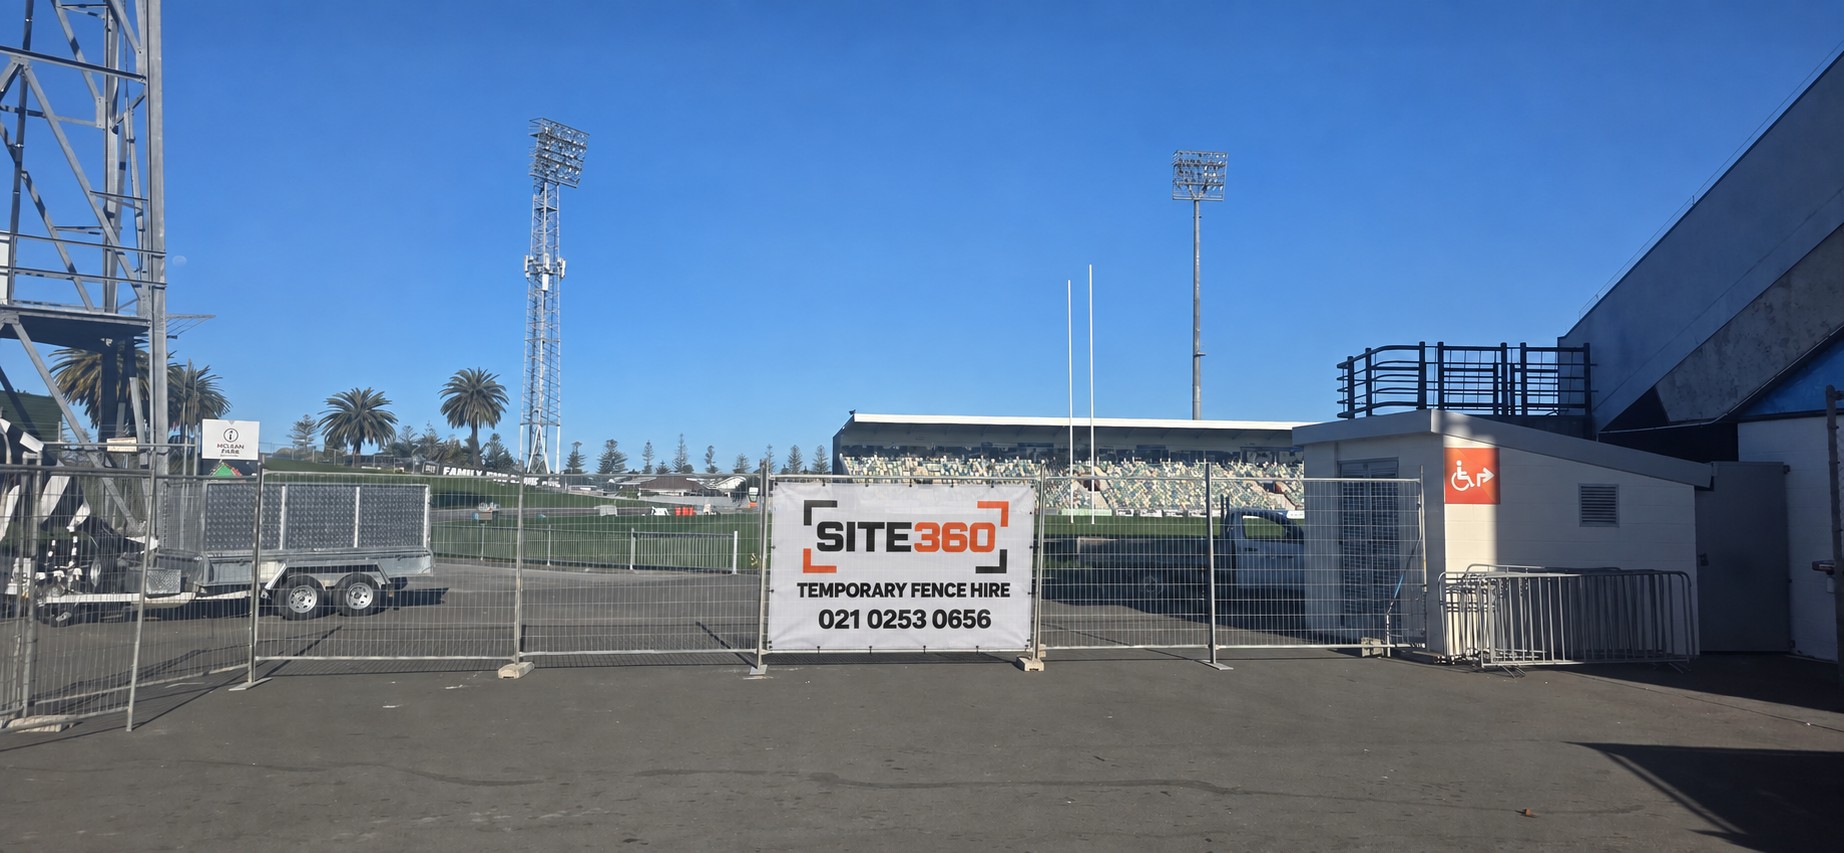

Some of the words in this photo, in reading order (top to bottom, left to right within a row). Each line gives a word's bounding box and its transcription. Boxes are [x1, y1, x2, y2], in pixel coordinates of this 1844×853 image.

[442, 466, 483, 477] FAMILY
[816, 521, 996, 553] SITE360
[796, 582, 907, 598] TEMPORARY
[910, 582, 967, 598] FENCE
[970, 582, 1011, 598] HIRE
[818, 608, 860, 630] 021
[867, 608, 927, 630] 0253
[931, 608, 992, 630] 0656
